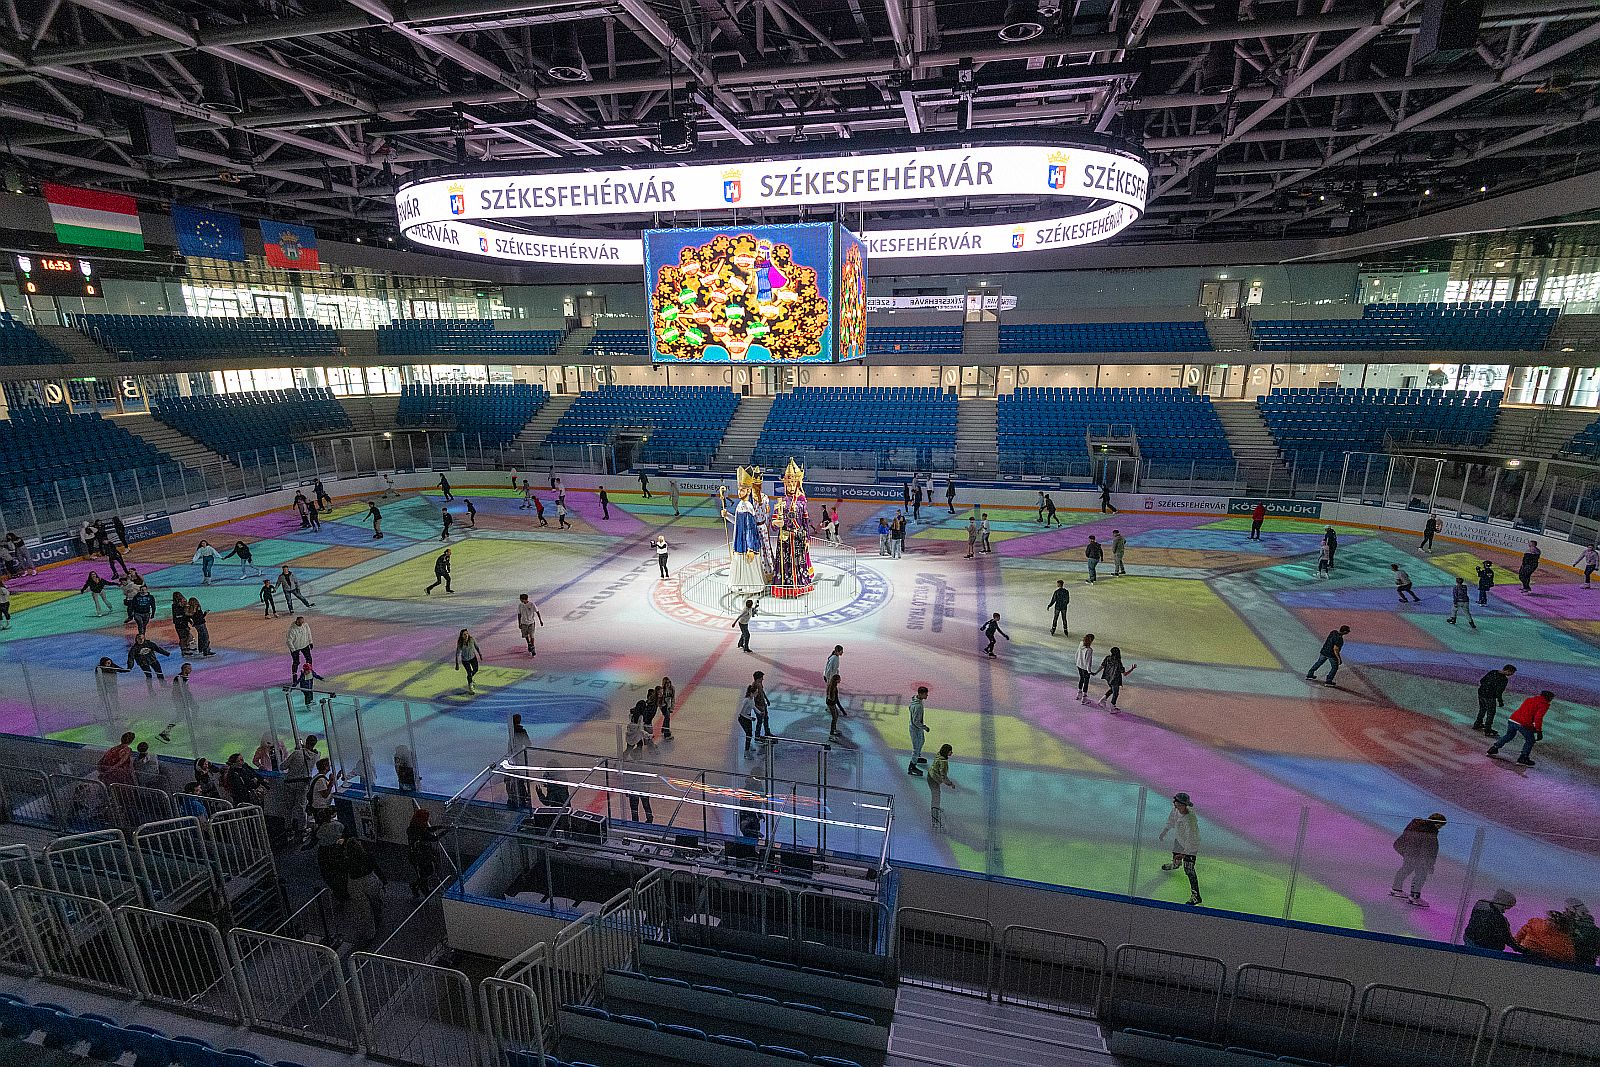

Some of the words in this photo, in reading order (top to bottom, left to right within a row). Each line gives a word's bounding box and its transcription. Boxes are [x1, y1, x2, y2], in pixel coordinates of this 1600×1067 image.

[759, 156, 993, 198] SZÉKESFEHÉRVÁR
[480, 176, 676, 210] SZÉKESFEHÉRVÁR
[1035, 205, 1125, 245] SZÉKESFEHÉRVÁR
[495, 237, 620, 260] SZÉKESFEHÉRVÁR
[41, 259, 72, 271] 16:53
[27, 282, 36, 293] 0
[86, 285, 95, 295] 0
[1157, 500, 1227, 511] SZÉKESFEHÉRVÁR
[1231, 502, 1317, 514] KÖSÖNJÜK!
[127, 525, 149, 535] ALBA
[128, 530, 157, 541] ARENA
[563, 553, 659, 622] GRUNDFO
